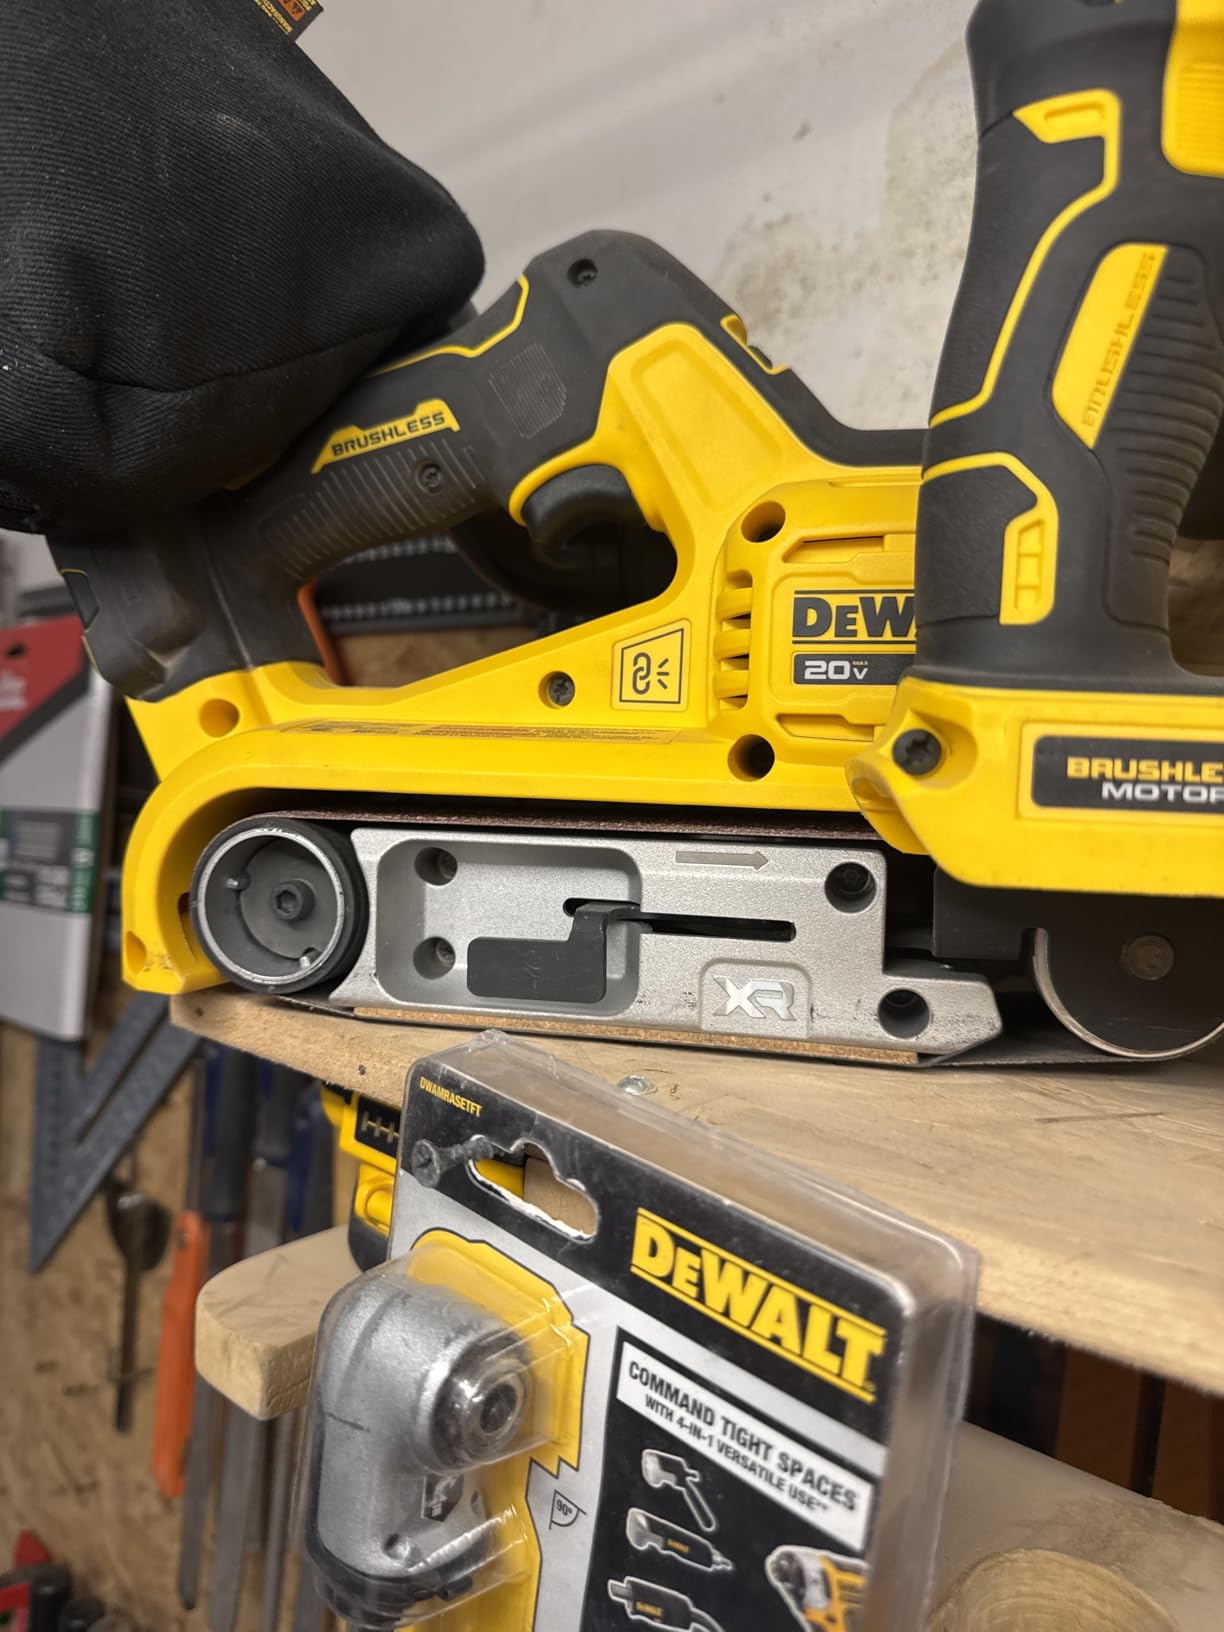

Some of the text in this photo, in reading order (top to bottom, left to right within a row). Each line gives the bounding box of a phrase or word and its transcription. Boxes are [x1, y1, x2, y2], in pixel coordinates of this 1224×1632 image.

[331, 411, 446, 457] BRUSHLESS
[792, 596, 917, 638] DEW
[1066, 754, 1224, 784] BRUSHLE
[712, 977, 797, 1021] XR
[420, 1076, 482, 1117] DWAMRASETFT
[632, 1212, 885, 1388] DEWALT
[629, 1360, 857, 1511] COMMAND TIGHT SPACES
[645, 1394, 674, 1422] WITH
[676, 1416, 713, 1448] 4-IN-1
[717, 1439, 786, 1492] VERSATILE
